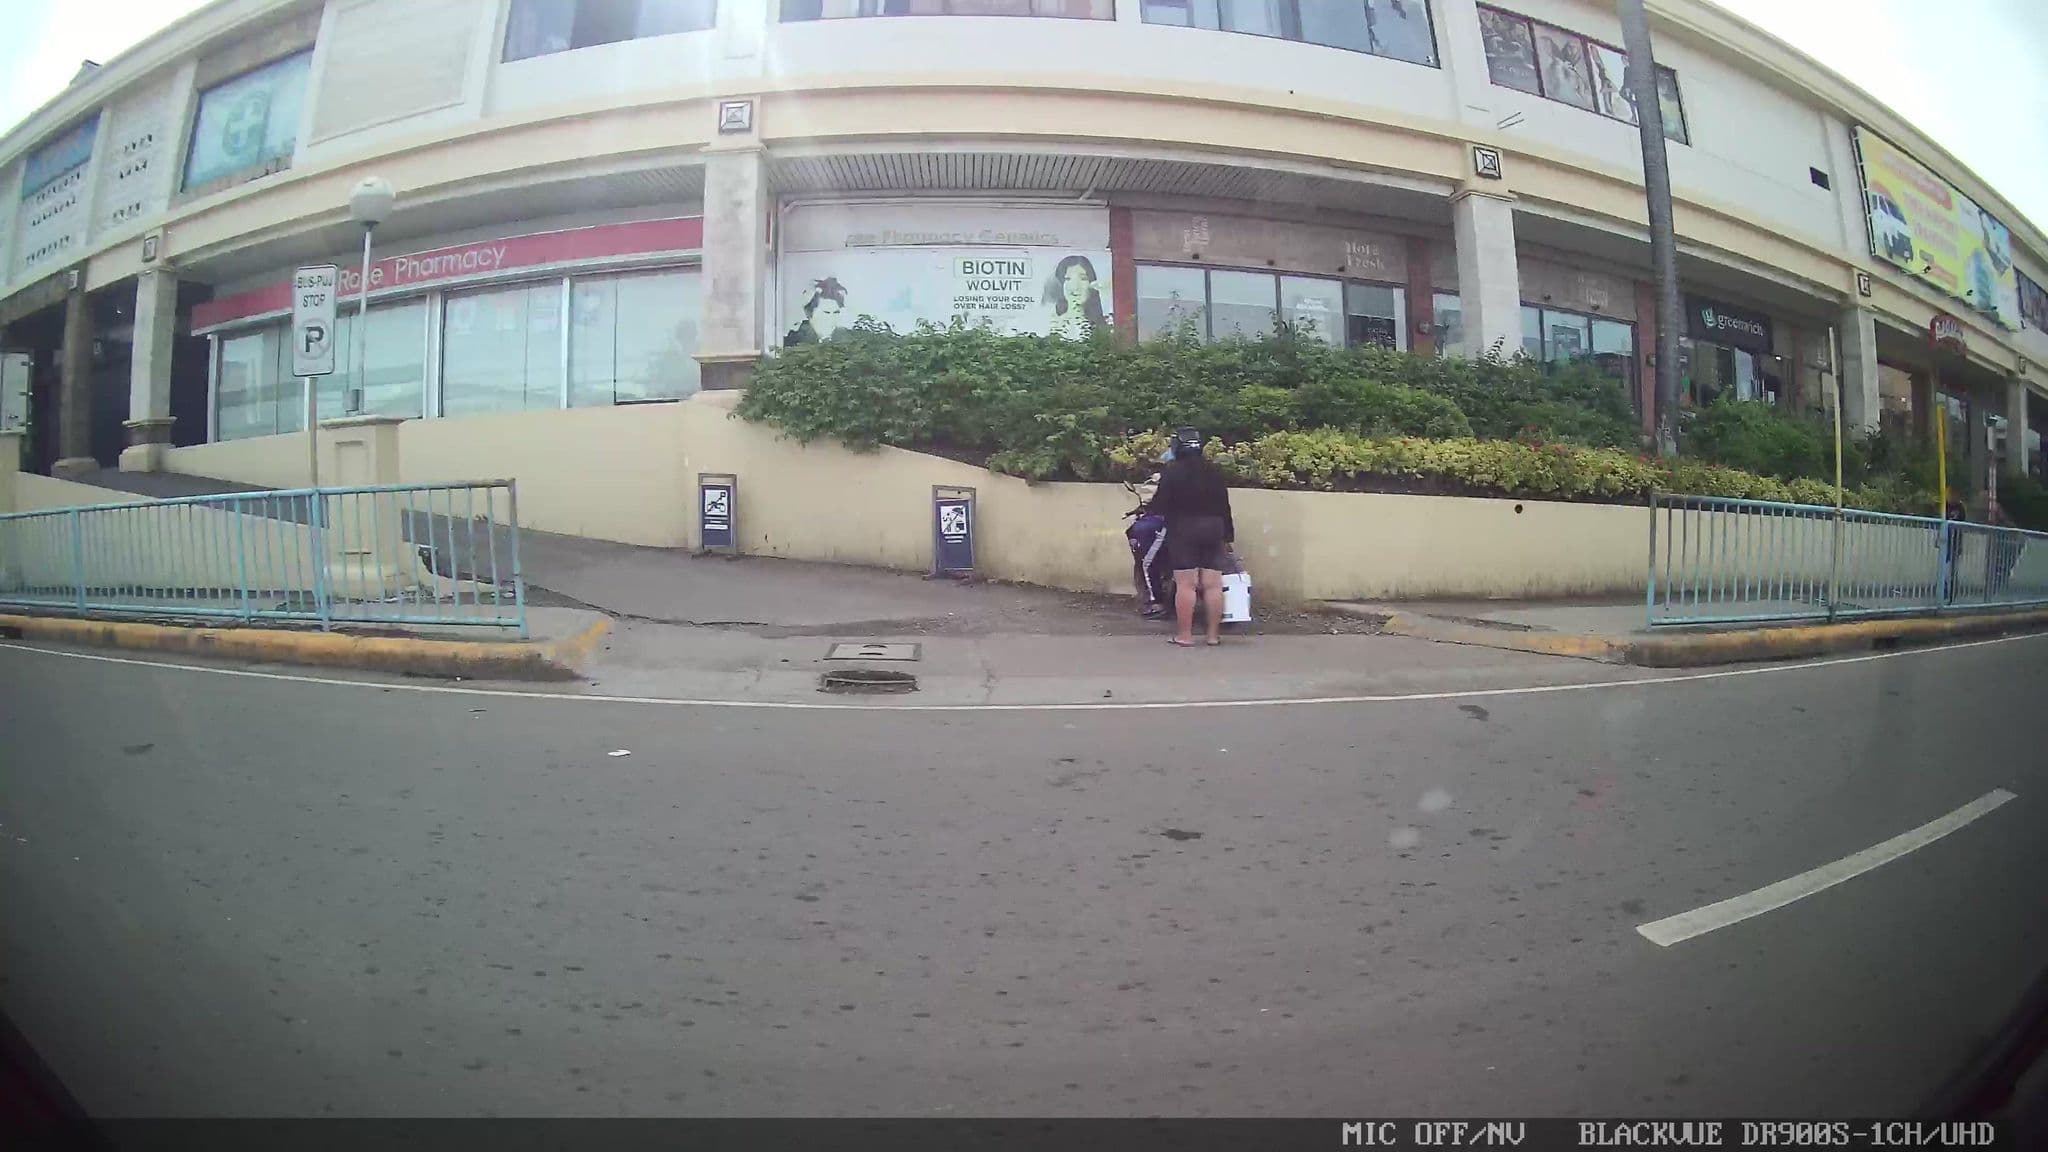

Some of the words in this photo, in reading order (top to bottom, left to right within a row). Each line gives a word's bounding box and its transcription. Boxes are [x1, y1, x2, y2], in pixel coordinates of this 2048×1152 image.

[338, 267, 384, 292] Roe
[395, 247, 506, 284] Pharmacy
[963, 261, 1025, 275] BIOTIN
[966, 279, 1022, 291] WOLVIT
[302, 293, 326, 308] STOP
